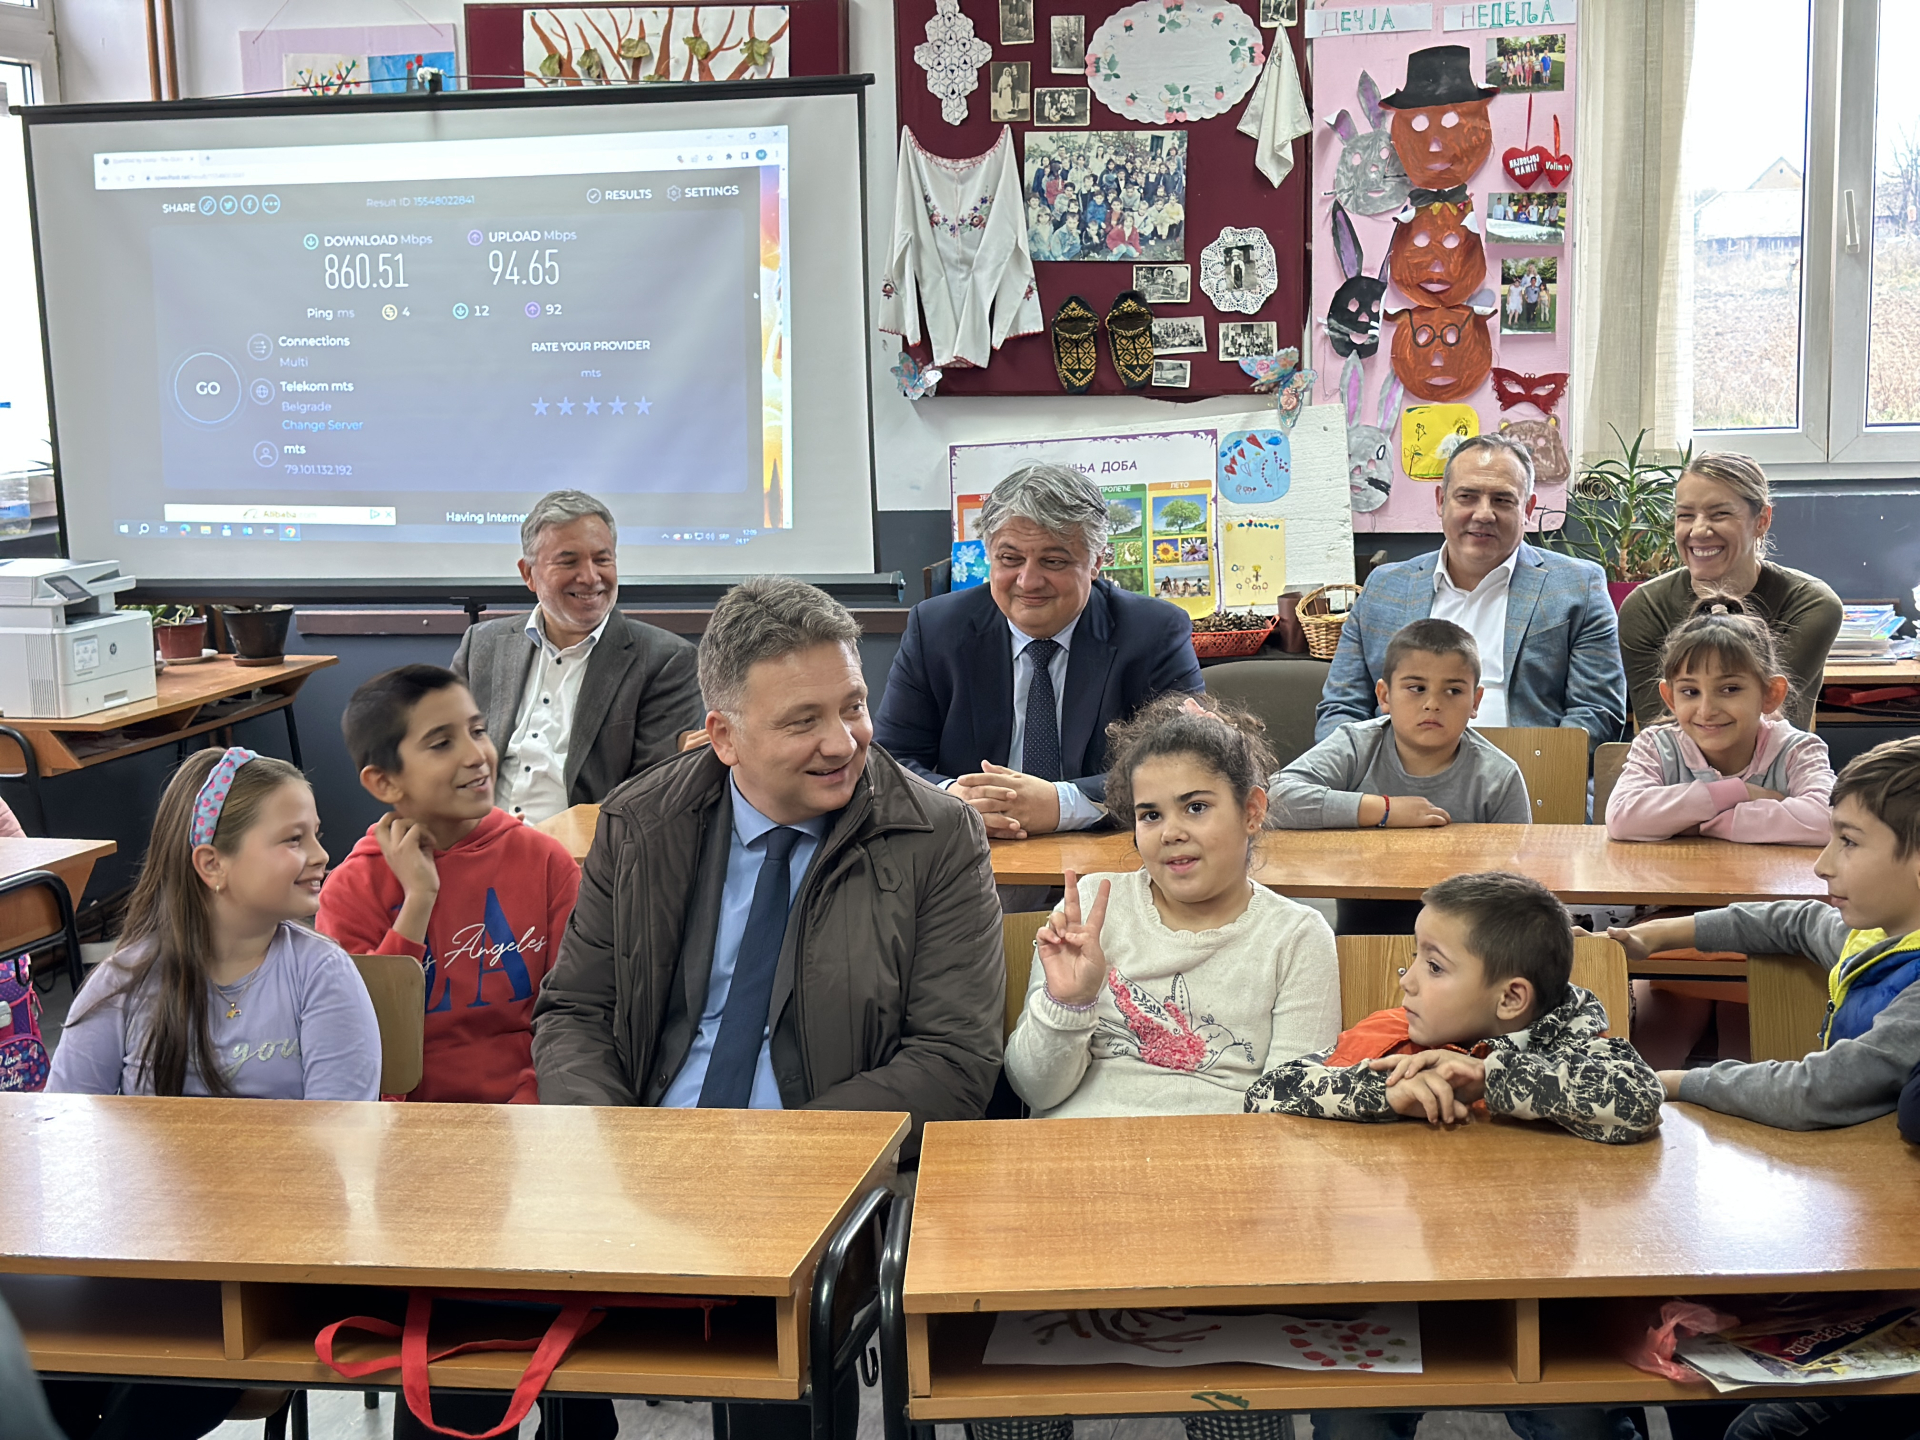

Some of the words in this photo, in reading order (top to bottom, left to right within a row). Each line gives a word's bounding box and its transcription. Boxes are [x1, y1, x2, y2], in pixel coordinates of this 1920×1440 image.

[1321, 7, 1396, 35] ДЕЧЈА
[1461, 0, 1555, 28] НЕДЕЉА
[1545, 161, 1563, 171] Volim
[605, 188, 653, 200] RESULTS
[684, 185, 739, 198] SETTINGS
[366, 198, 397, 207] Result
[399, 197, 411, 206] ID
[413, 195, 475, 206] 15548022841
[162, 202, 196, 214] SHARE
[324, 234, 398, 247] DOWNLOAD
[400, 233, 433, 246] Mbps
[488, 230, 541, 243] UPLOAD
[544, 230, 577, 242] Mbps
[324, 252, 409, 289] 860.51
[488, 249, 560, 286] 94.65
[307, 307, 333, 321] Ping
[337, 309, 355, 318] ms
[402, 307, 410, 317] 4
[474, 306, 490, 317] 12
[545, 304, 562, 315] 92
[278, 335, 350, 348] Connections
[531, 342, 559, 352] RATE
[560, 341, 591, 351] YOUR
[593, 340, 650, 351] PROVIDER
[279, 356, 308, 367] Multi
[581, 368, 601, 378] mts
[196, 382, 220, 395] GO
[280, 381, 328, 392] Telekom
[331, 380, 354, 392] mts
[282, 400, 331, 414] Belgrade
[282, 420, 326, 432] Change
[328, 420, 364, 431] Server
[284, 444, 306, 454] mts
[285, 464, 353, 476] 79.101.132.192
[1100, 460, 1138, 474] ДОБА
[1170, 481, 1190, 489] ЛЕТО
[446, 512, 484, 524] Having
[444, 923, 547, 970] Angeles
